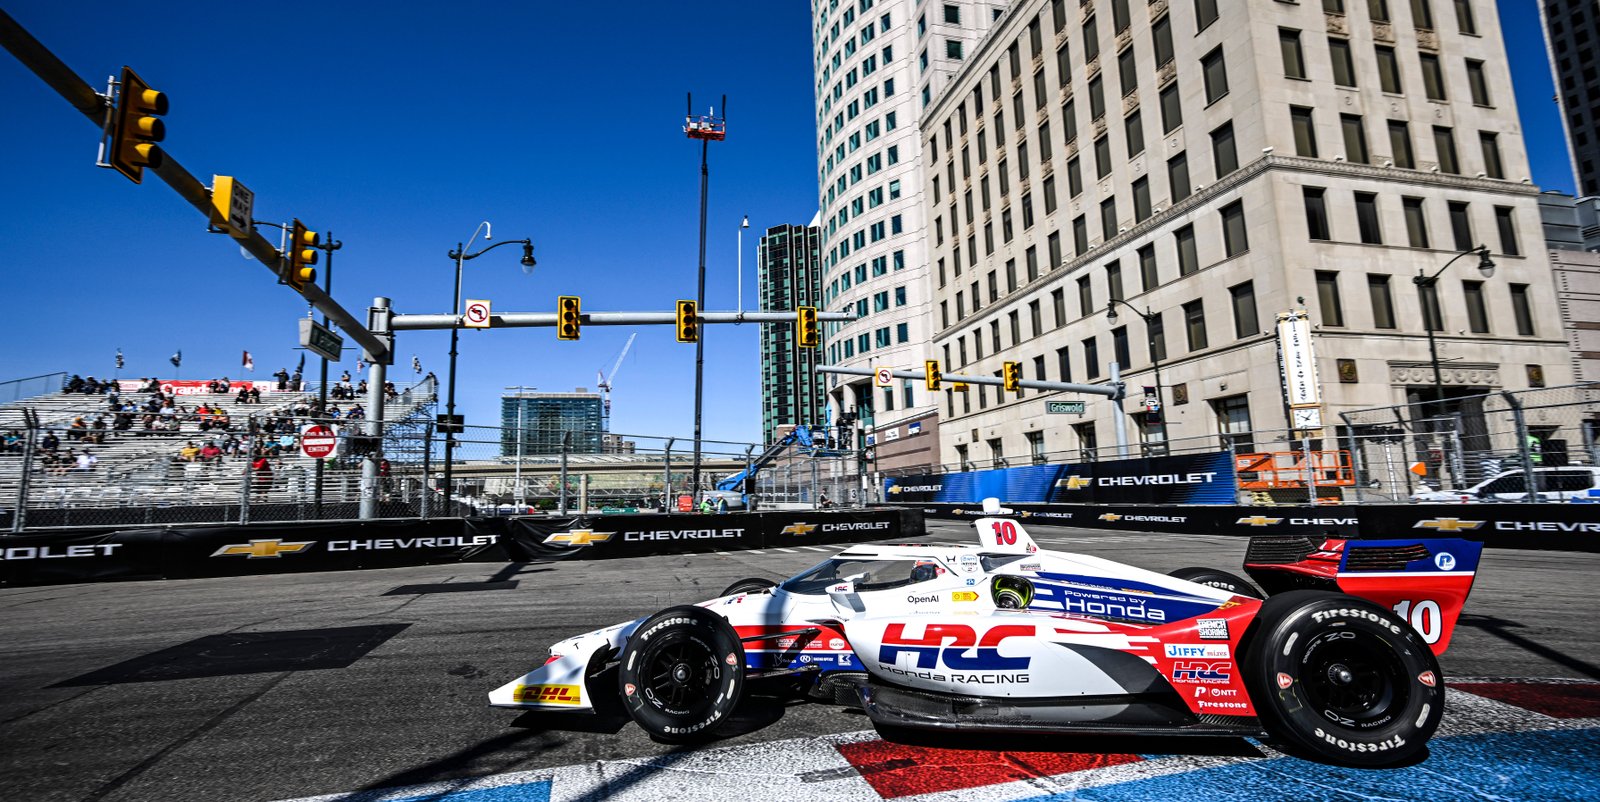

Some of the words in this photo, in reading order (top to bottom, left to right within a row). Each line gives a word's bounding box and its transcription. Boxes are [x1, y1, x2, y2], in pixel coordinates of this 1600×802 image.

[1051, 403, 1083, 412] Griswold
[1098, 471, 1218, 487] CHEVROLET
[851, 489, 857, 498] 3
[821, 520, 891, 532] CHEVROLET
[1124, 514, 1188, 523] CHEVROLET
[624, 528, 745, 541] CHEVROLET
[992, 521, 1017, 546] 10
[1495, 521, 1600, 533] CHEVR
[327, 534, 500, 551] CHEVROLET
[0, 543, 123, 560] OLET
[907, 594, 940, 605] OpenAI
[1065, 590, 1126, 602] Powered
[1129, 597, 1146, 605] by
[1065, 598, 1166, 621] Honda
[640, 617, 698, 641] Firestone
[1311, 608, 1401, 635] Firestone
[1392, 599, 1443, 645] 10
[878, 623, 1036, 670] HRC
[1168, 645, 1205, 656] JIFFY
[879, 664, 946, 682] Honda
[951, 673, 1030, 684] RACING
[1172, 661, 1232, 680] HRC
[523, 686, 573, 701] DHL
[1197, 700, 1247, 709] Firestone
[663, 709, 722, 734] Firestone
[1361, 715, 1392, 728] RACING
[1314, 727, 1406, 753] Firestone
